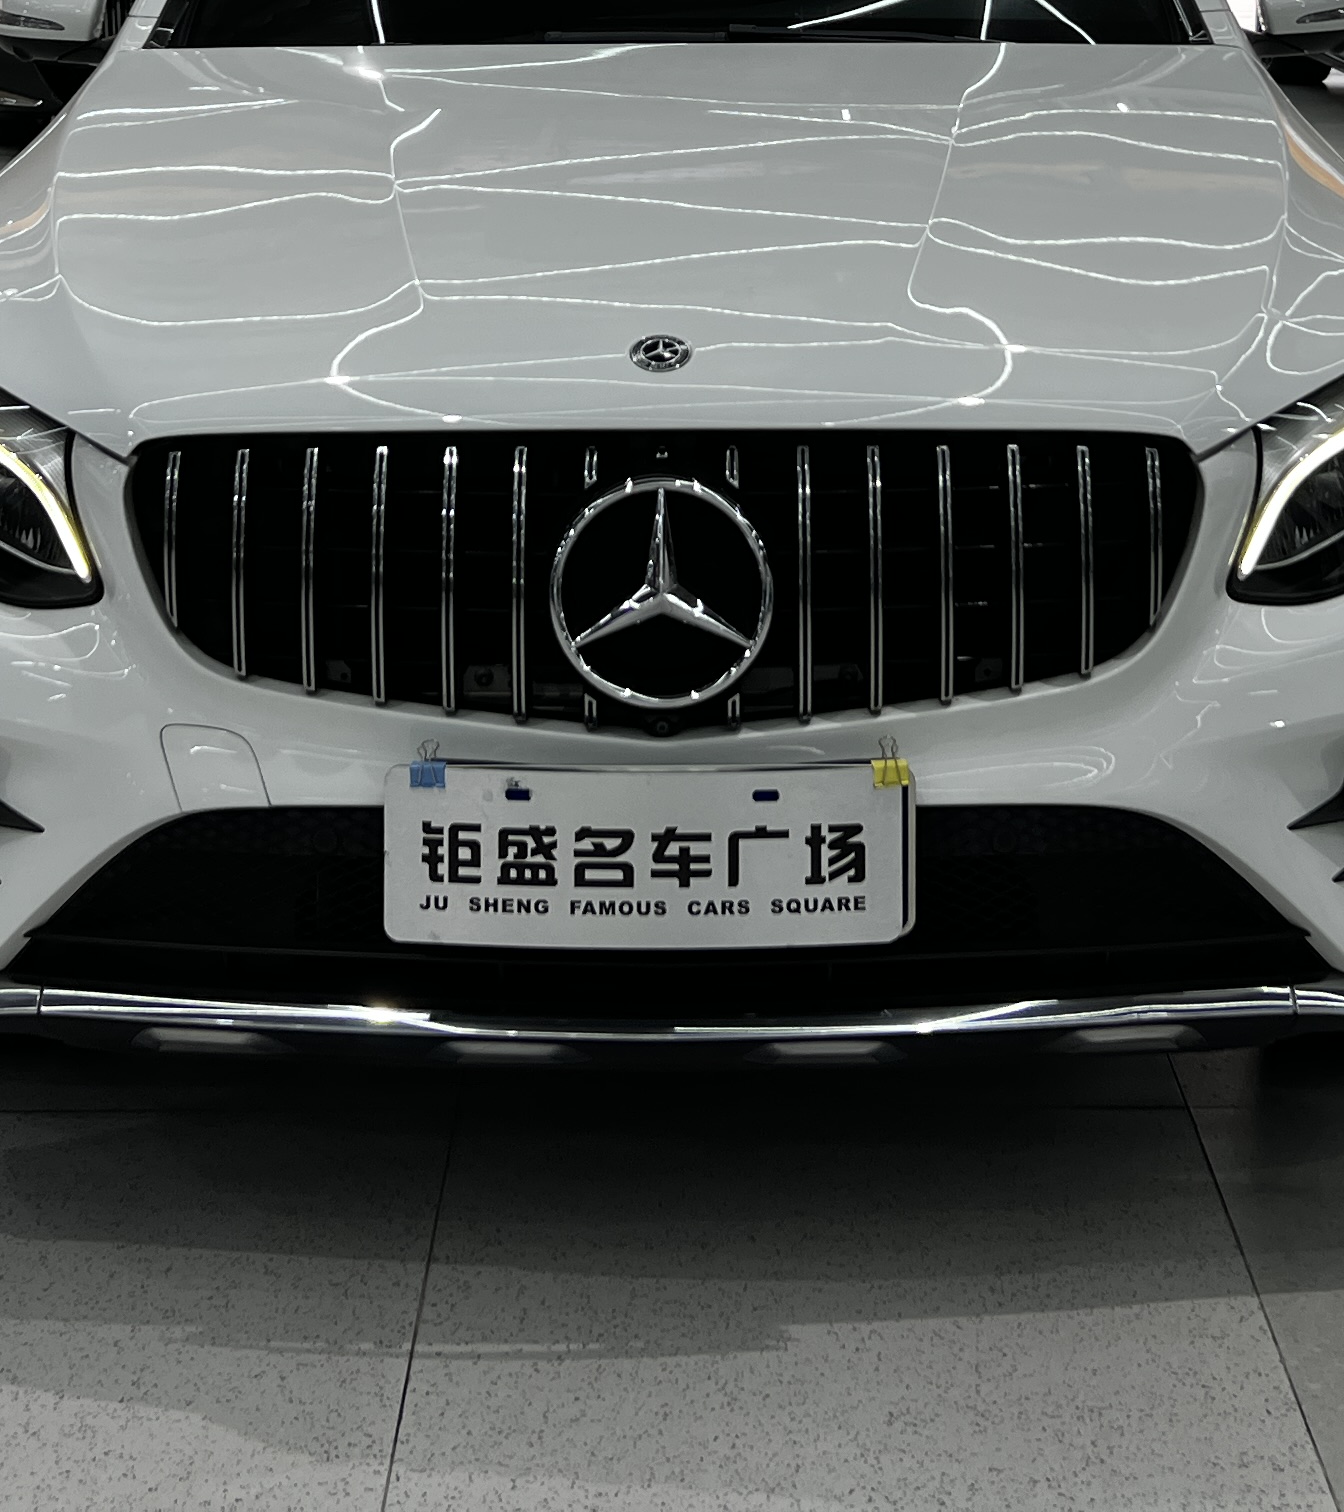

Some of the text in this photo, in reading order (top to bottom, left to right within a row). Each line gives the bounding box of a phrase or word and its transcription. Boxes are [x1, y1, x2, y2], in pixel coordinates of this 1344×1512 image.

[421, 820, 867, 889] 钜盛名车广场
[419, 895, 867, 917] JU SHENG FAMOUS CARS SQUARE
